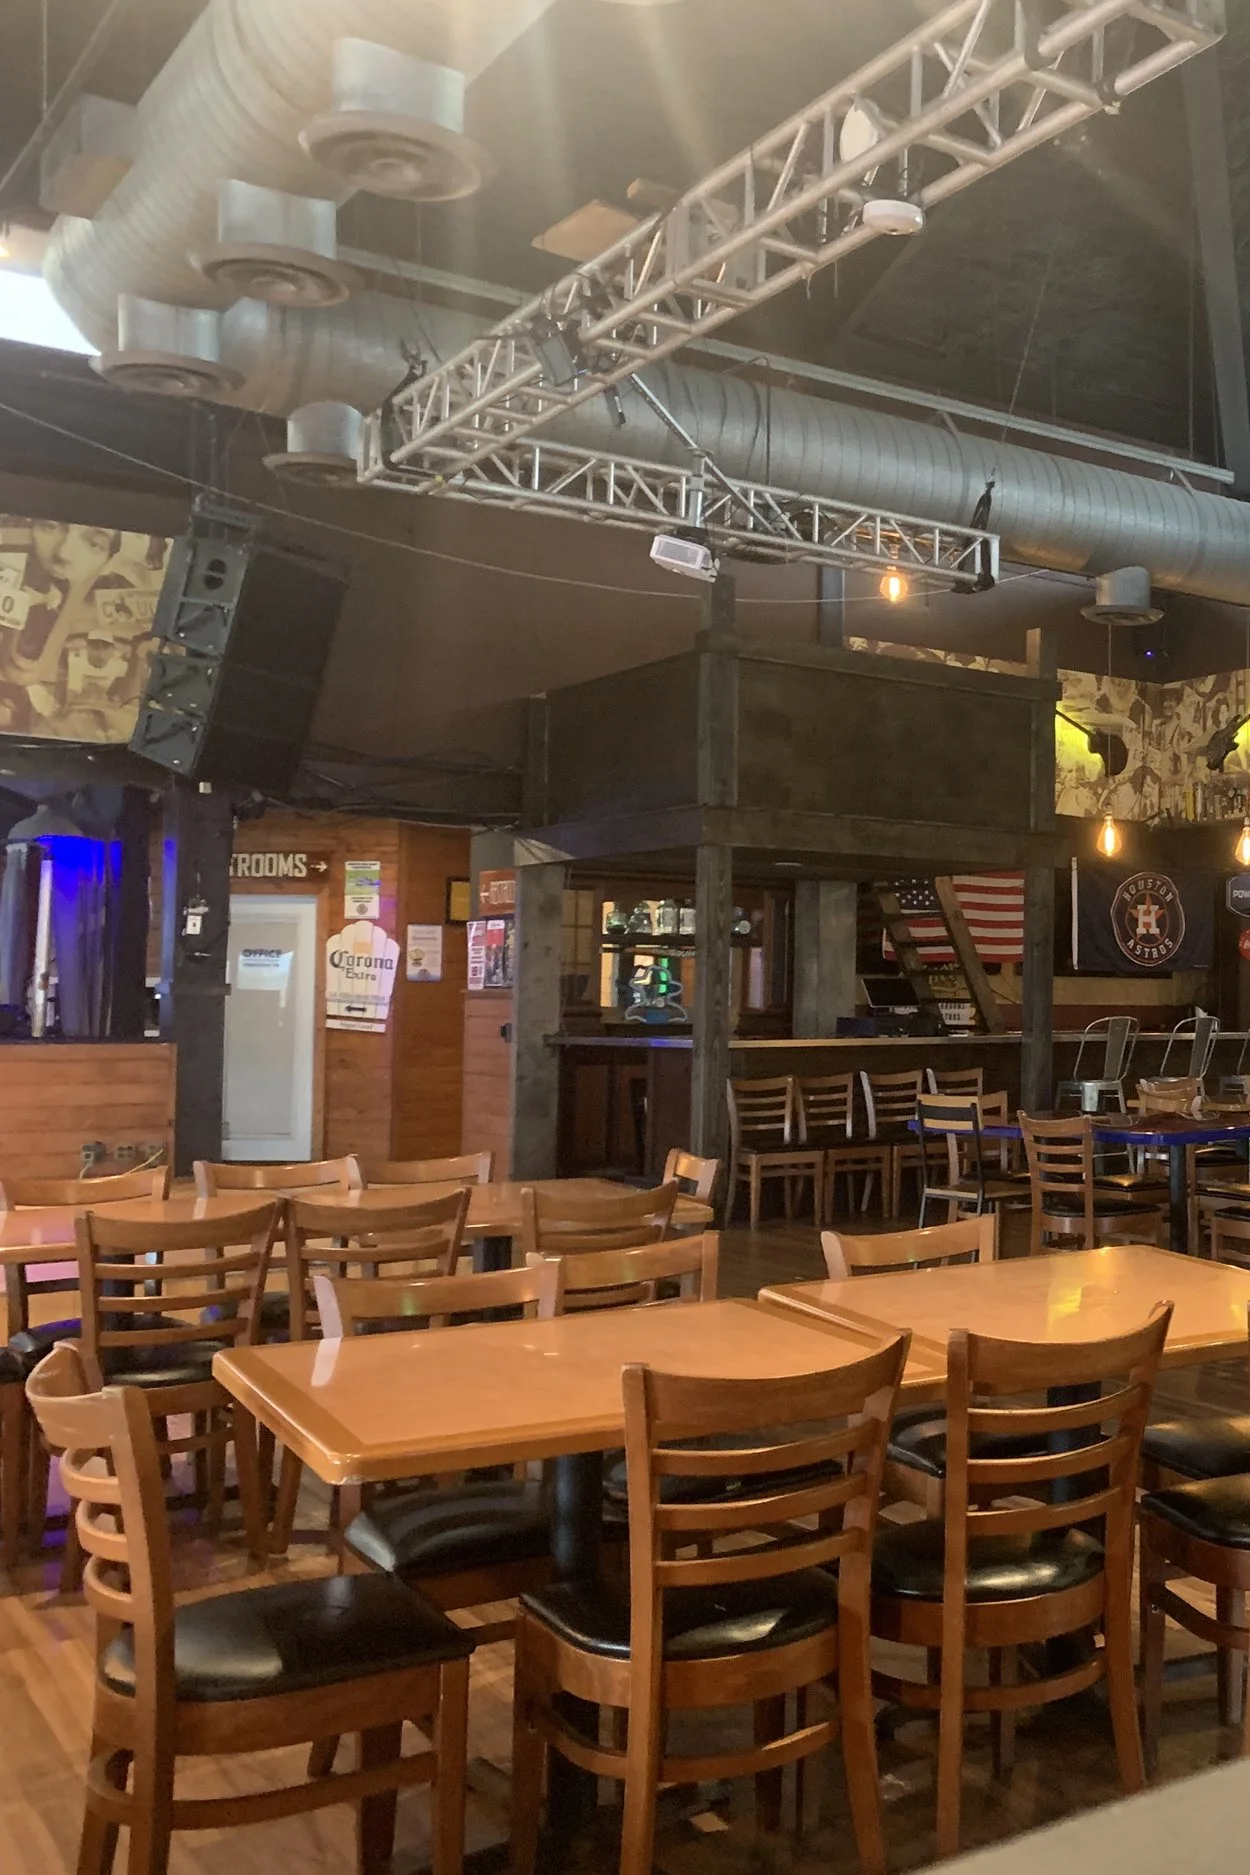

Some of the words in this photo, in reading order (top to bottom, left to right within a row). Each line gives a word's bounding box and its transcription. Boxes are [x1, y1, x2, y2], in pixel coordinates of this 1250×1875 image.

[1122, 879, 1174, 902] HOUSTON
[1127, 938, 1173, 958] ASTROS
[329, 949, 394, 971] Corona
[344, 966, 377, 981] Extra
